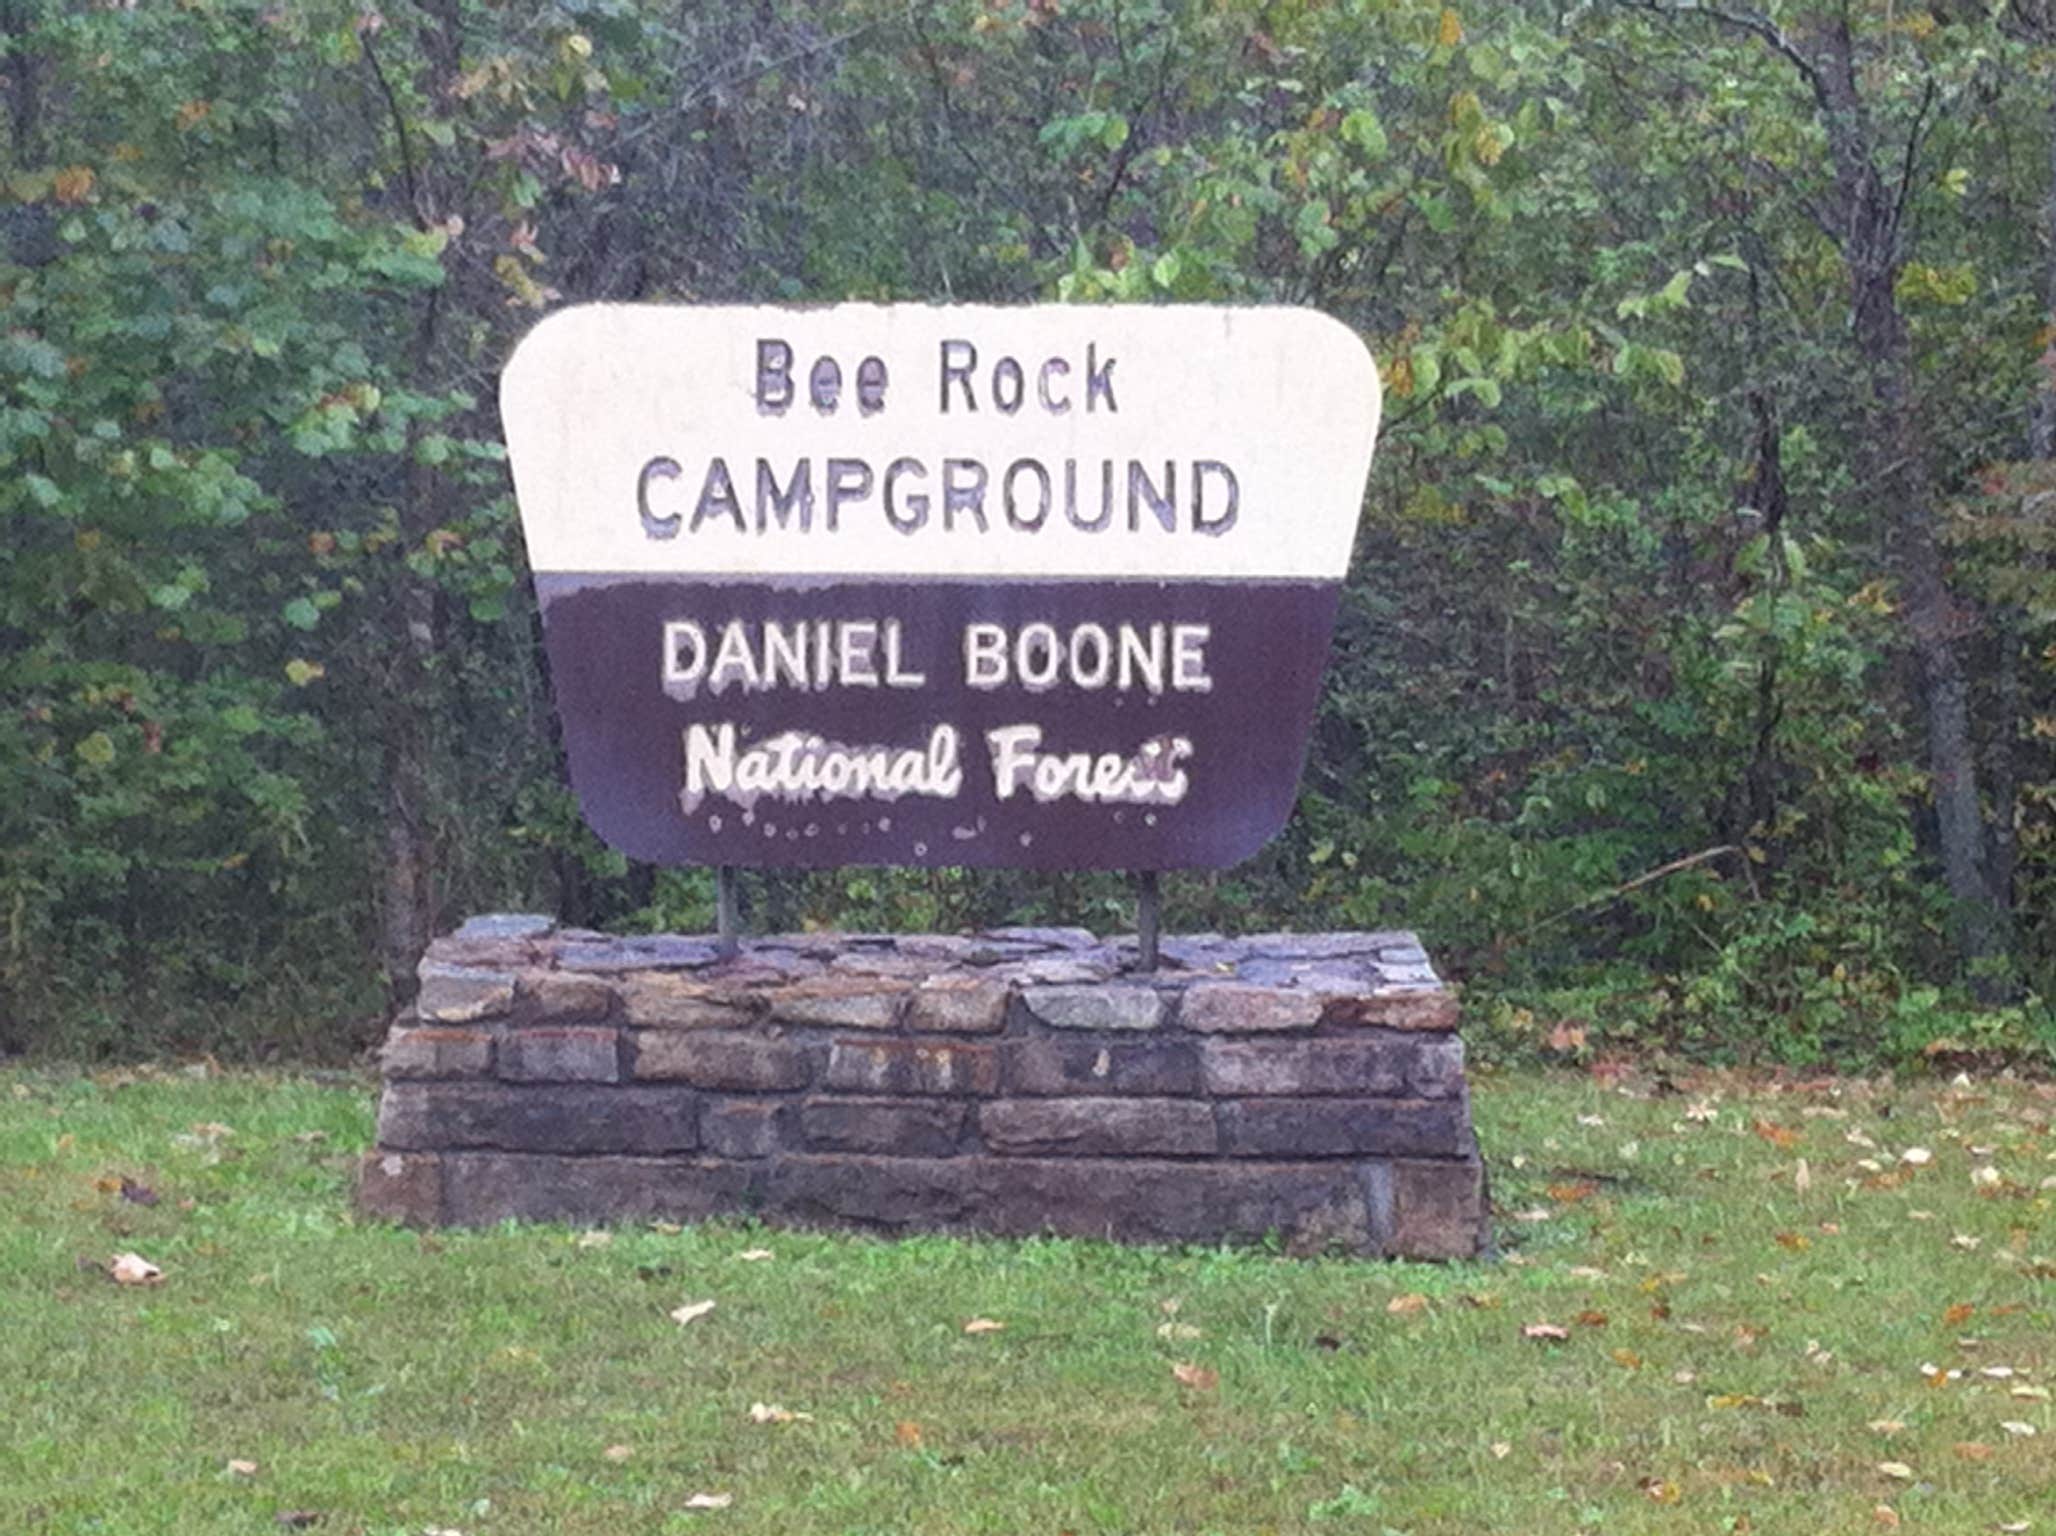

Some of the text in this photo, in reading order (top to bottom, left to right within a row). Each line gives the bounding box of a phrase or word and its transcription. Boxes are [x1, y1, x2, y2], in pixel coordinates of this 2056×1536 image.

[753, 338, 1119, 416] Bee Rock
[636, 455, 1240, 539] CAMPGROUND
[662, 619, 1213, 699] DANIEL BOONE
[682, 722, 963, 808] National
